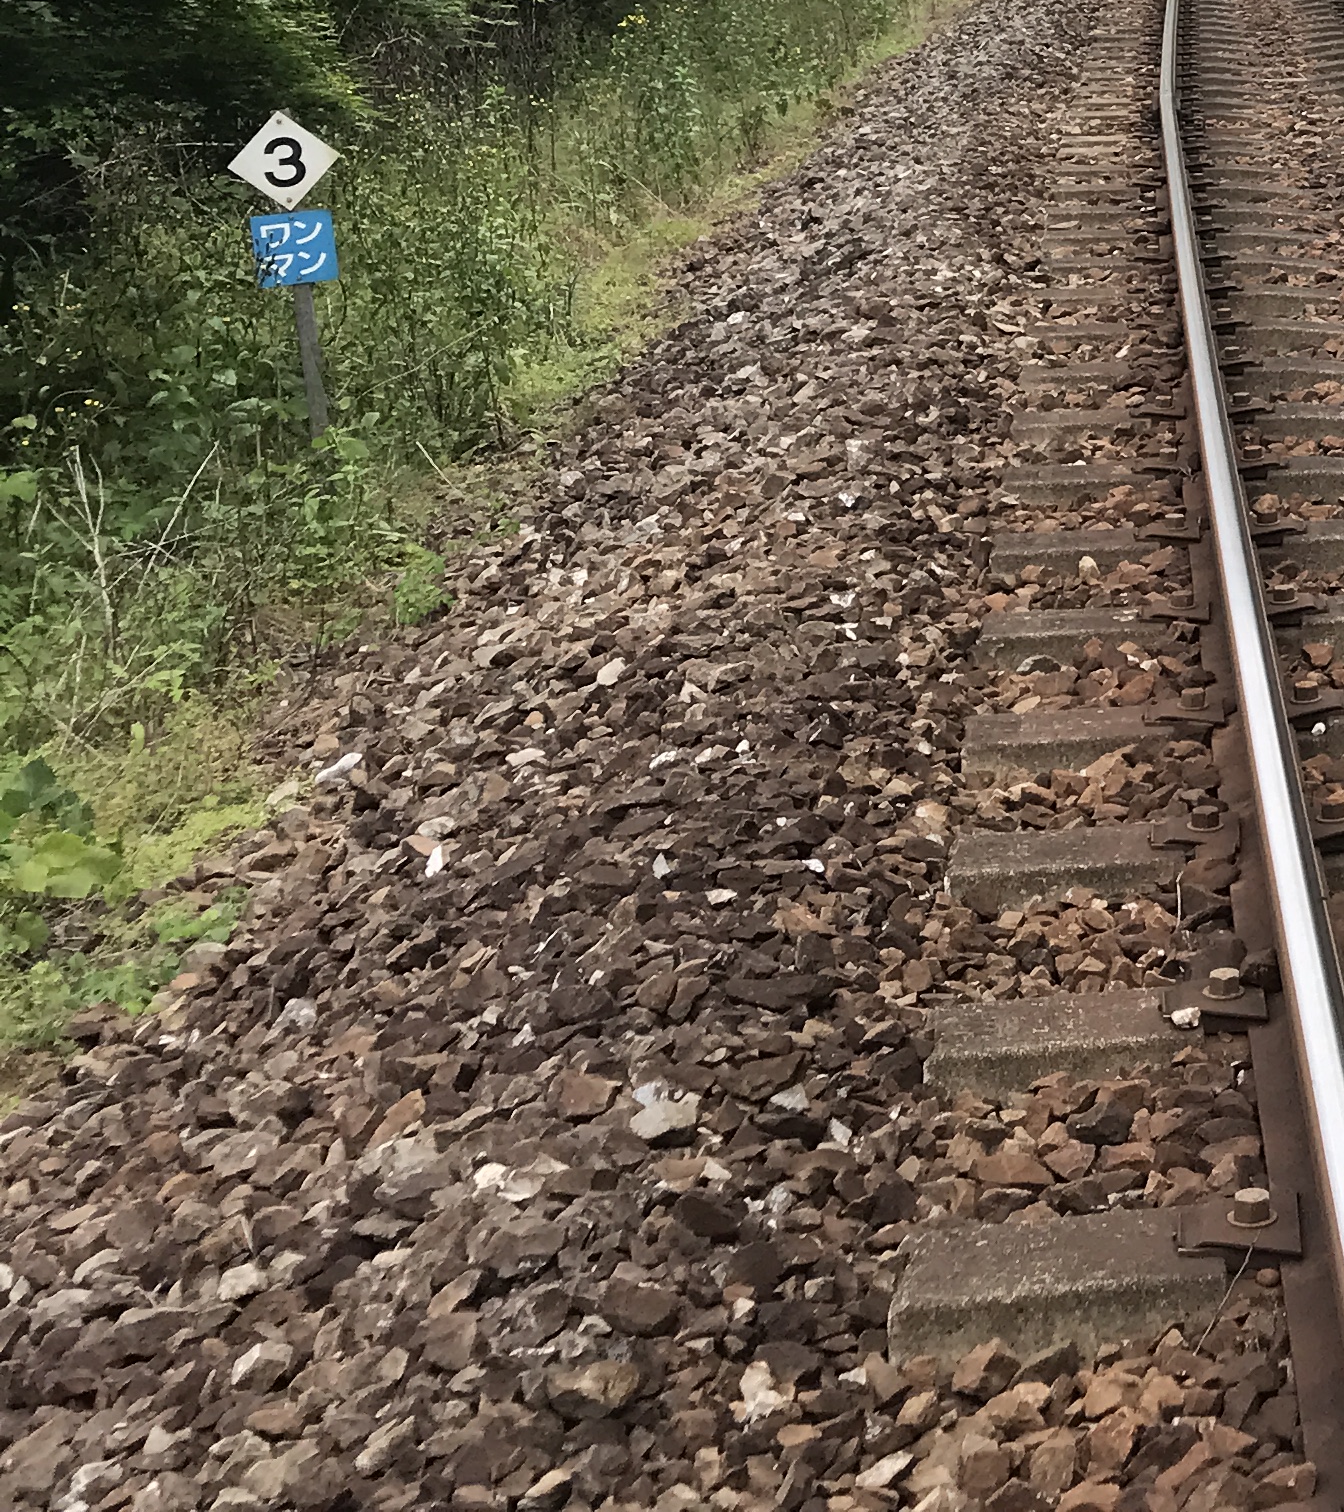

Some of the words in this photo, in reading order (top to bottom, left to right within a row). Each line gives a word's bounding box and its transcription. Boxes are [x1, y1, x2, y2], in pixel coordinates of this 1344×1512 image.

[254, 136, 306, 188] 3
[260, 222, 322, 248] ワン
[263, 252, 327, 277] マン
